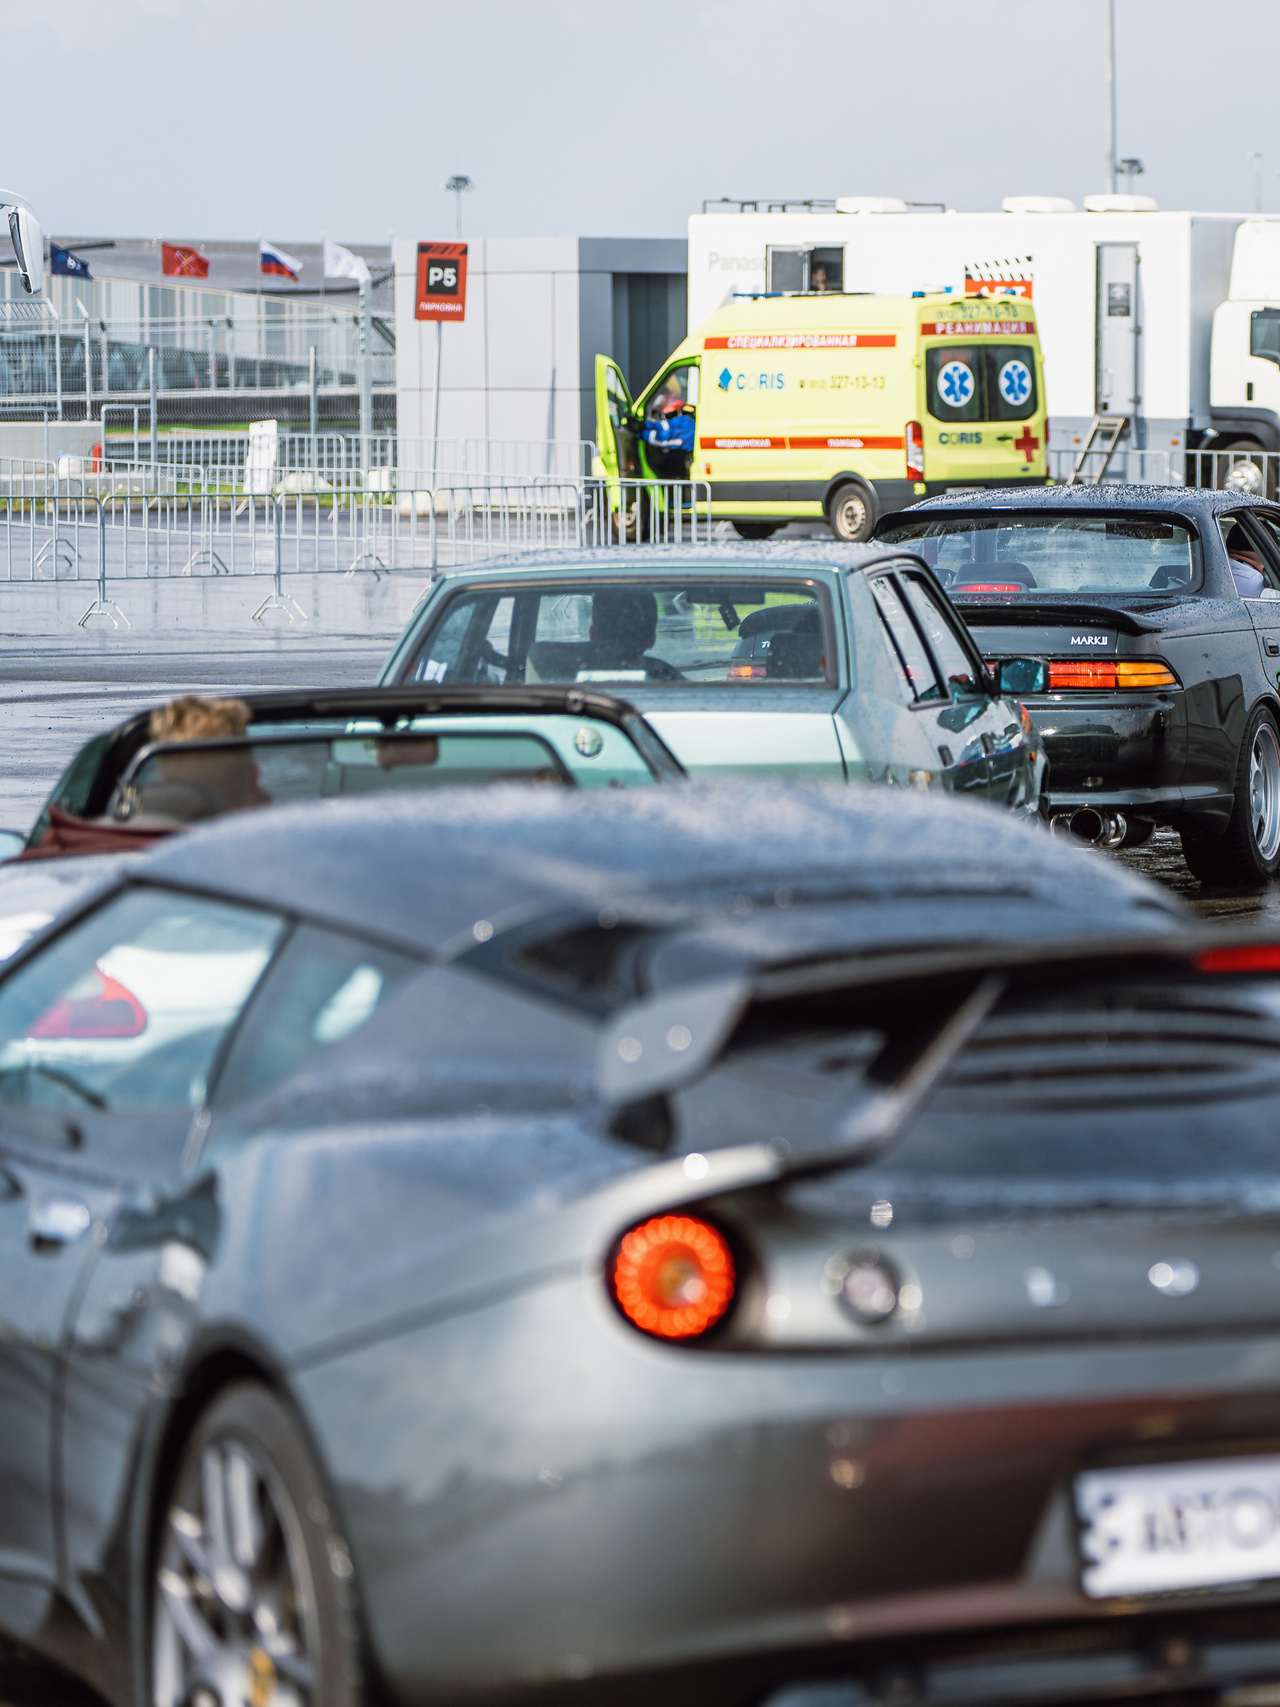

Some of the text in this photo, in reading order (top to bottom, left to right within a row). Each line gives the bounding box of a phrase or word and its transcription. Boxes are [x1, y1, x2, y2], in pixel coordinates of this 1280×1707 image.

[428, 267, 457, 287] P5
[935, 322, 1027, 334] РЕАНИМАЦИЯ
[728, 335, 857, 348] СПЕЦИАЛИЗИРОВАННАЯ
[736, 373, 785, 390] CORIS
[830, 375, 886, 389] 327-13-13
[939, 432, 982, 445] CORIS
